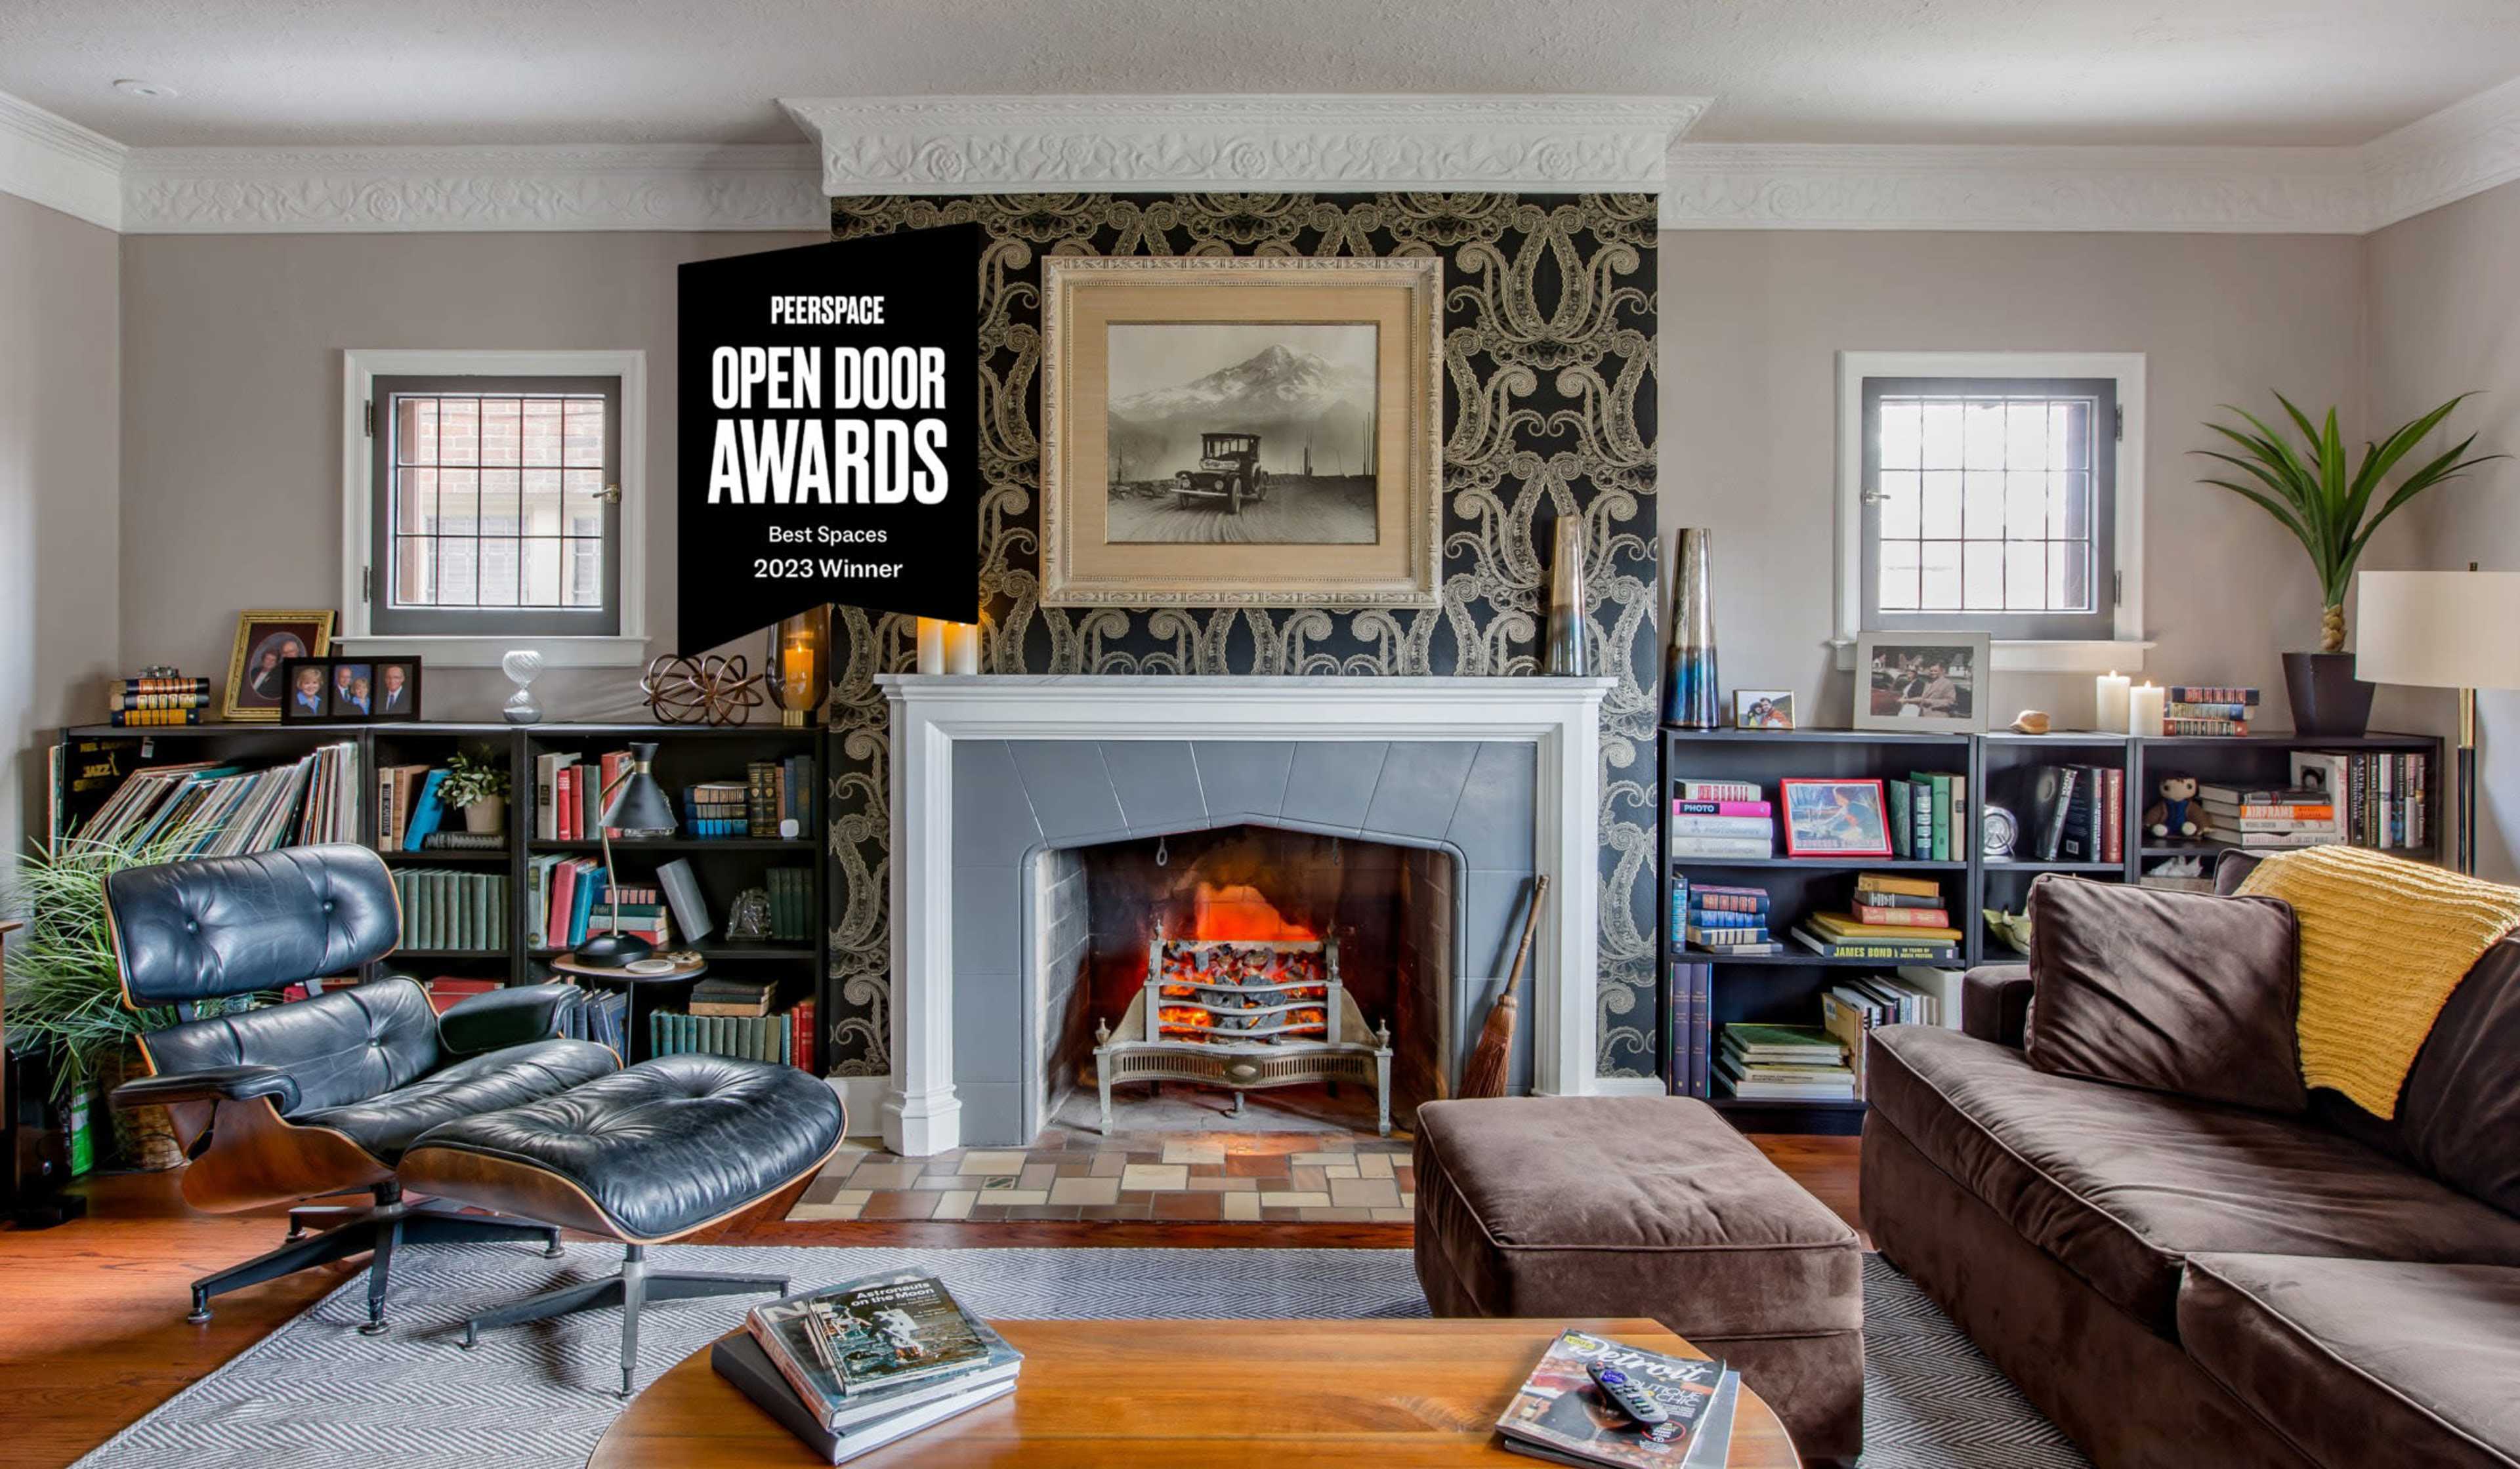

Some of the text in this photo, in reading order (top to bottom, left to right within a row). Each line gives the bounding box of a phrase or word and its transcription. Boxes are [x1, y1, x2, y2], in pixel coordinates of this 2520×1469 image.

[2246, 805, 2294, 819] AIRFRAME
[1834, 947, 1893, 958] JAMES BOND
[850, 1298, 870, 1306] on
[872, 1294, 894, 1304] the
[895, 1288, 934, 1299] Moon
[857, 1283, 931, 1299] Astronauts
[1569, 1334, 1713, 1381] Detroit
[1632, 1379, 1703, 1399] OUTIQUE
[1656, 1394, 1701, 1407] CHIC
